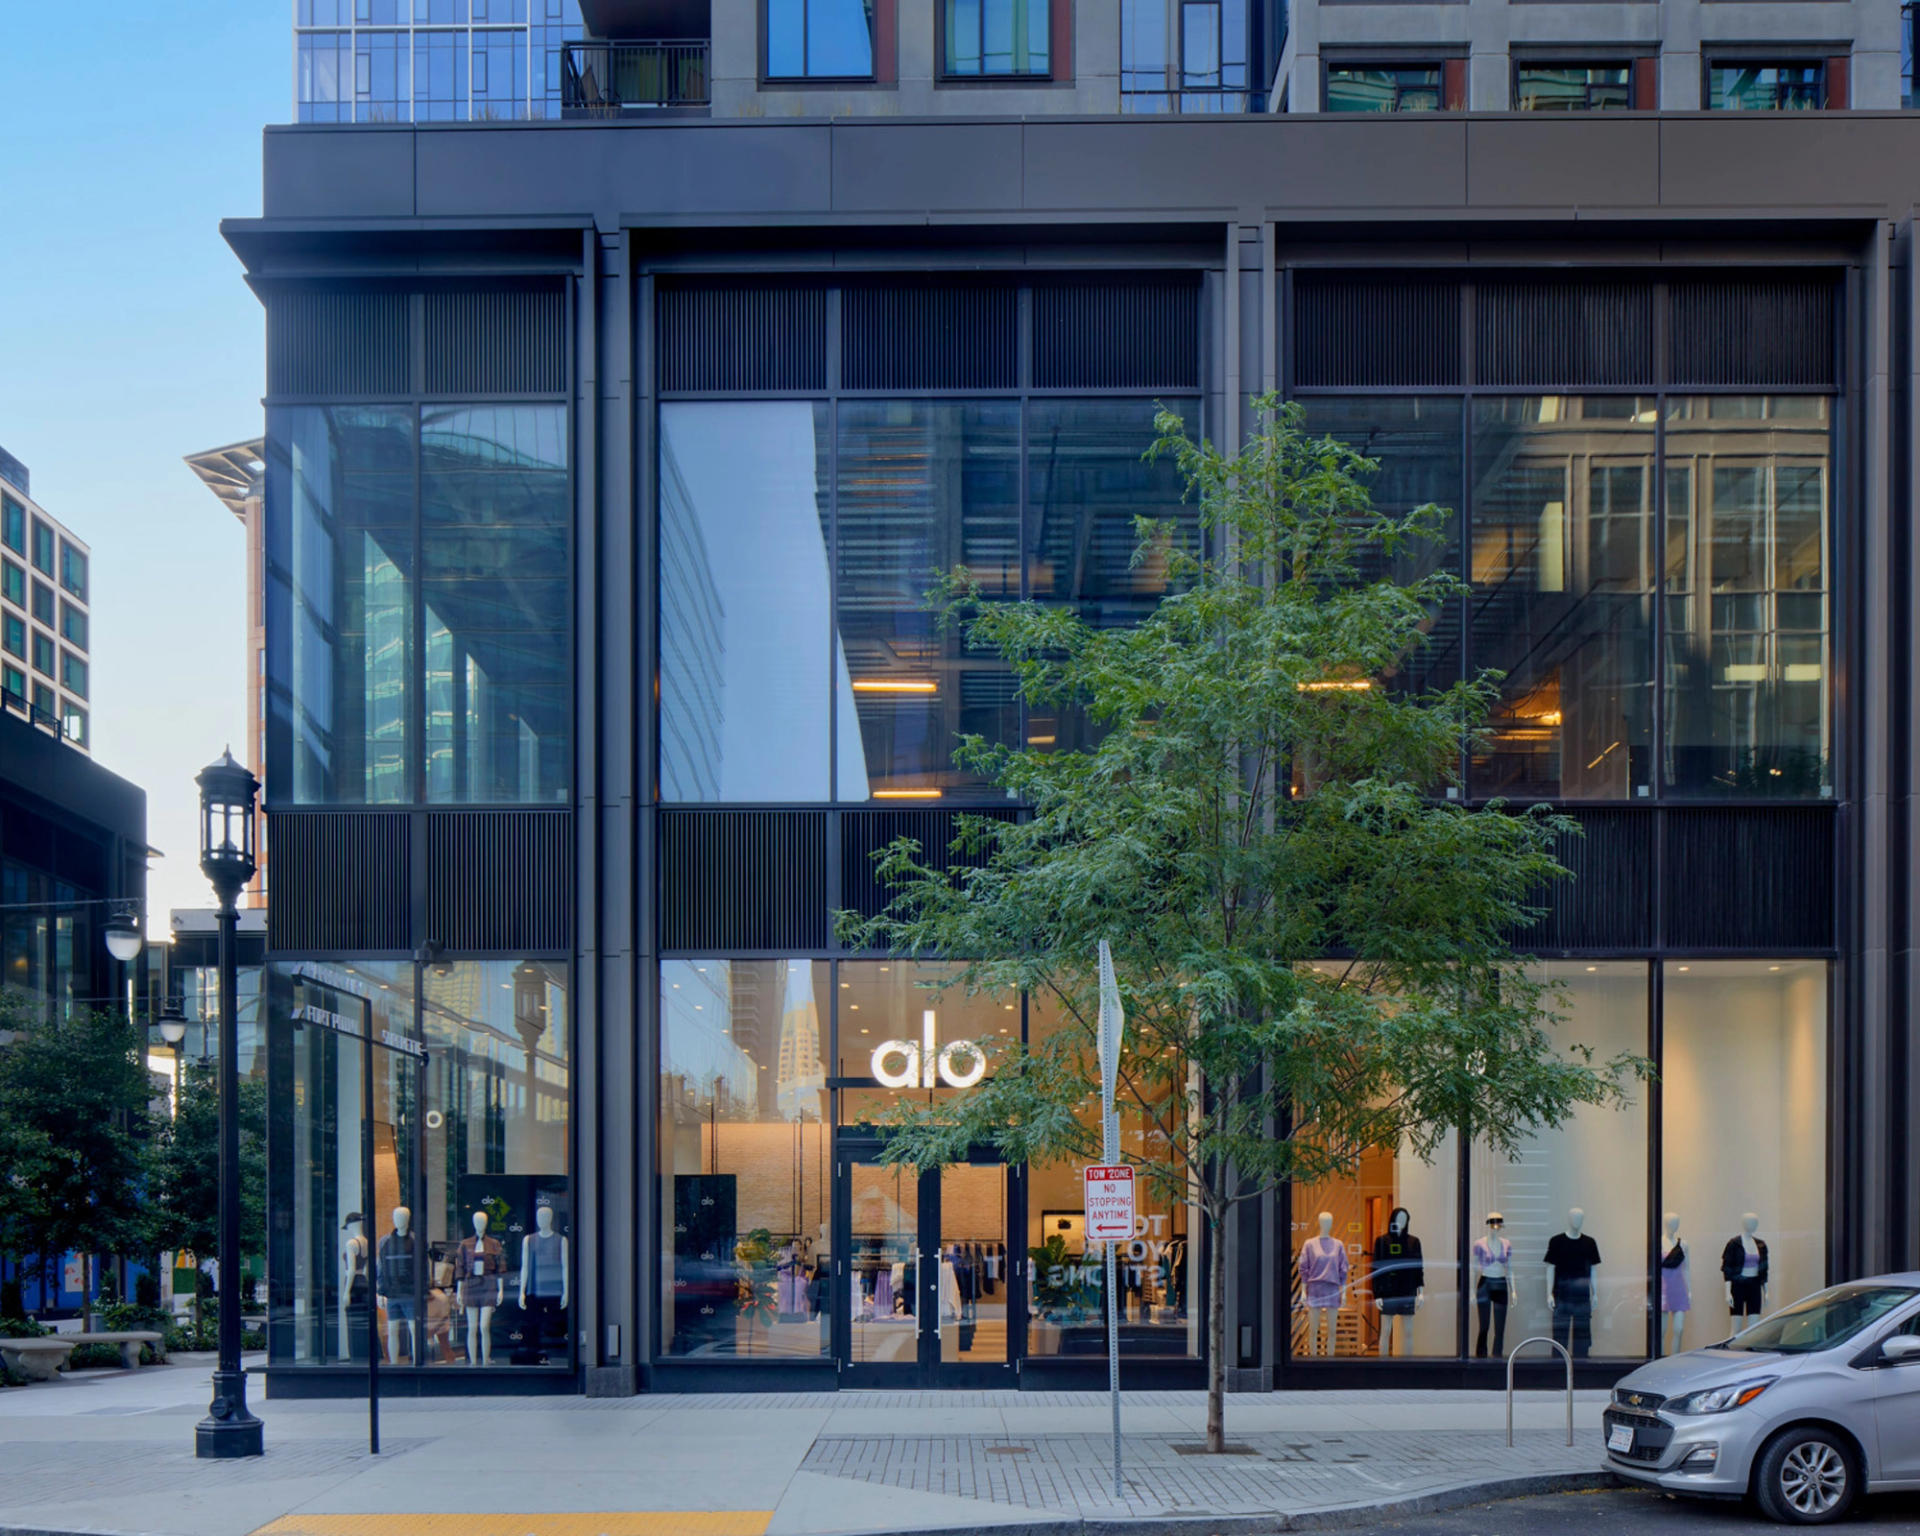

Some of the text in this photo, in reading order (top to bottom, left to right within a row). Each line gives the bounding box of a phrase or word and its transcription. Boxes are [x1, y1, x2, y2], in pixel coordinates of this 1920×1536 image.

[871, 1010, 986, 1088] alo
[1088, 1168, 1130, 1179] TOW ZONE
[1104, 1184, 1116, 1193] NO
[481, 1195, 495, 1205] alo
[536, 1196, 550, 1206] alo
[701, 1196, 714, 1206] alo
[1089, 1197, 1132, 1207] STOPPING
[1092, 1210, 1129, 1220] ANYTIME
[509, 1223, 523, 1232] alo
[701, 1251, 714, 1260] alo
[701, 1305, 714, 1314] alo
[509, 1331, 523, 1340] alo
